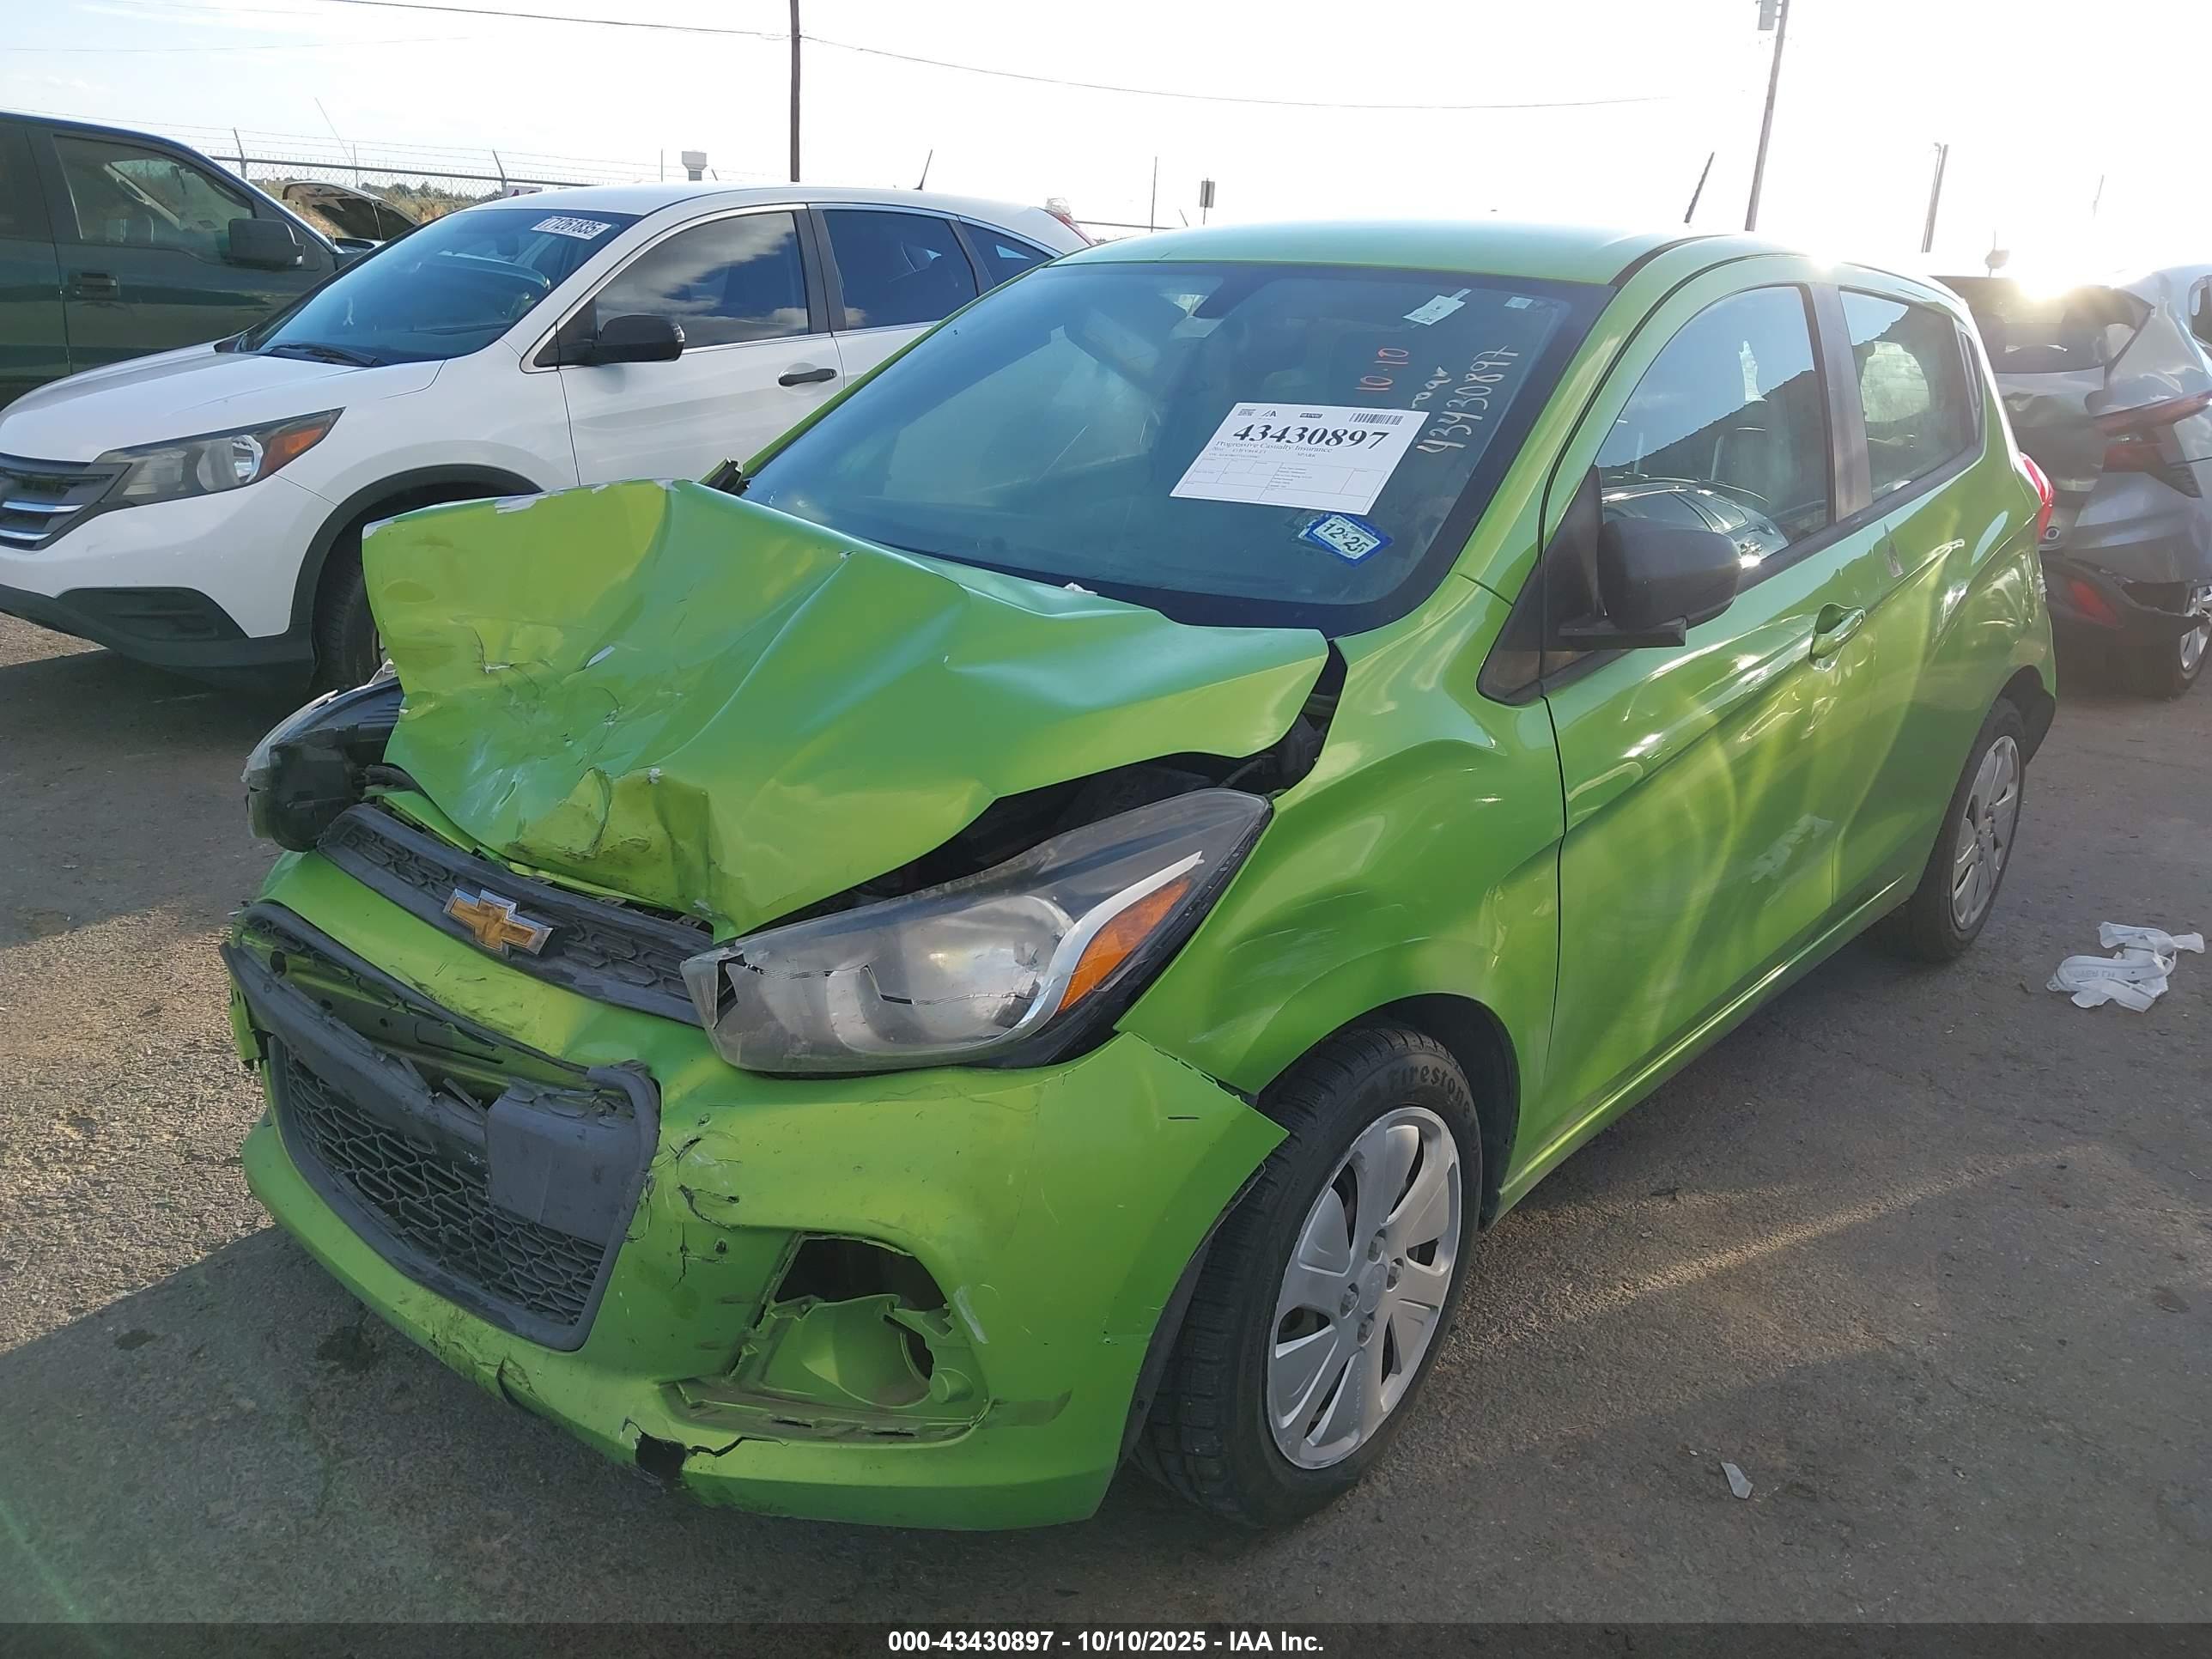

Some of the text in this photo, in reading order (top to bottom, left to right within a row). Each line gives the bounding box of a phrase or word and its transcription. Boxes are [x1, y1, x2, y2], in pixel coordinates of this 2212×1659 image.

[1416, 345, 1519, 453] 43430897
[1215, 441, 1259, 450] Progressive
[1260, 442, 1292, 453] Casualty
[1294, 445, 1334, 453] Insurance
[1232, 423, 1390, 450] 43430897
[1387, 1065, 1470, 1119] Firestone
